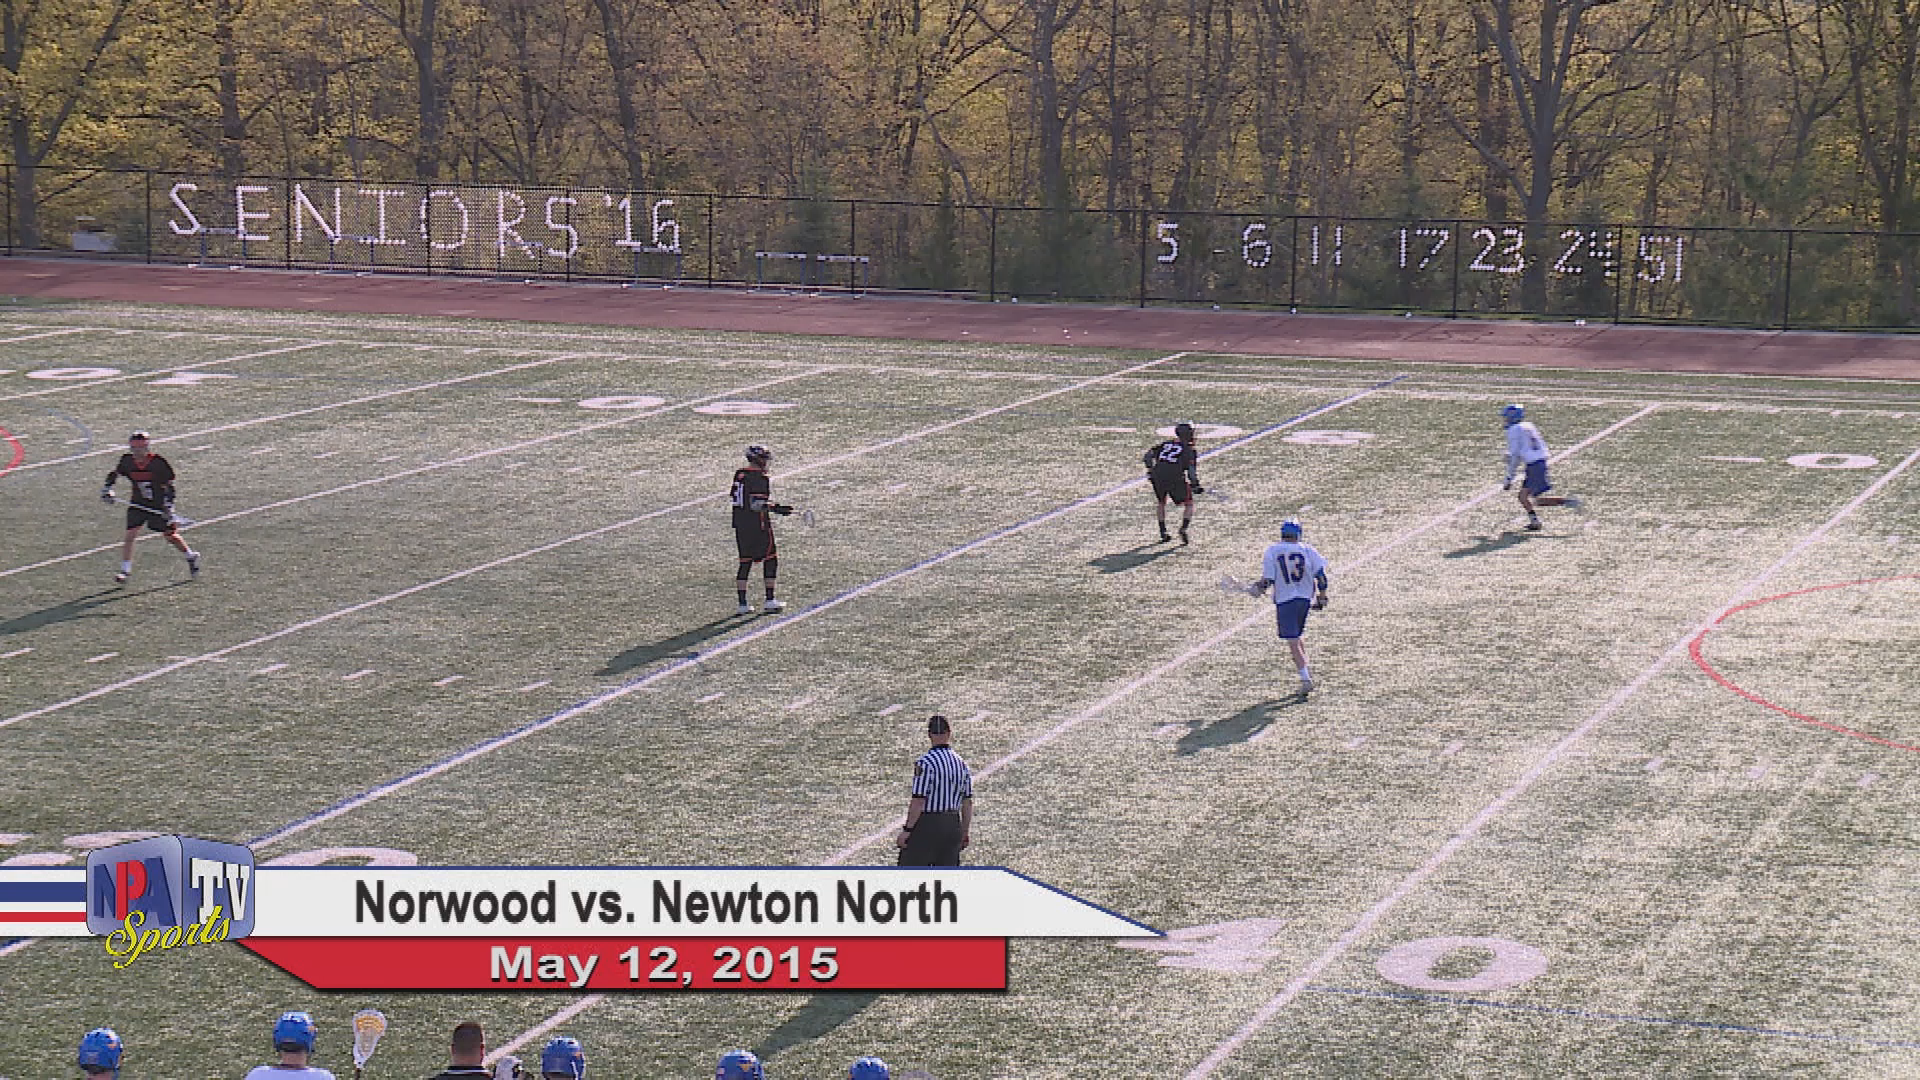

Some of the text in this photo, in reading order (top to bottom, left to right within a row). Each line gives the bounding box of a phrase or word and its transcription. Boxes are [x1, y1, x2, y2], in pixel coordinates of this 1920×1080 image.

[168, 182, 577, 258] SENIORS
[1156, 222, 1683, 283] 5 6 11 17 23 24 51
[1157, 443, 1183, 463] 22
[1276, 552, 1305, 584] 13
